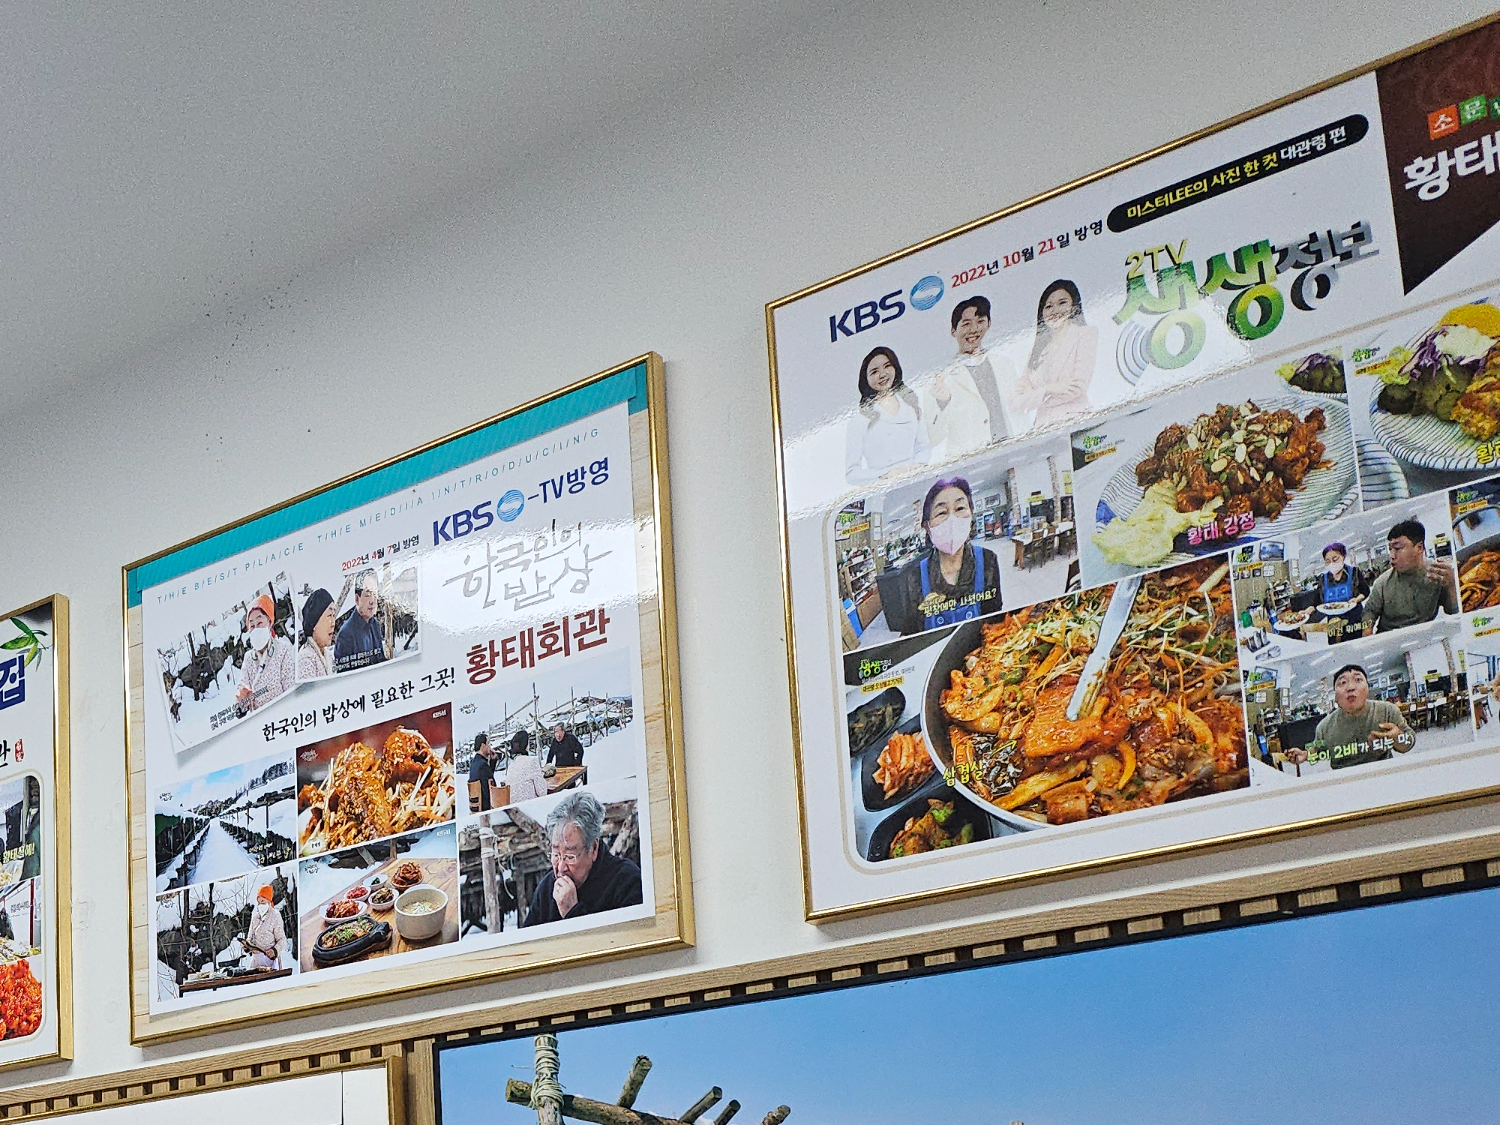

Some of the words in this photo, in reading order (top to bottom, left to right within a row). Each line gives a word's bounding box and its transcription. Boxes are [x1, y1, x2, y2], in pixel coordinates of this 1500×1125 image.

[1126, 181, 1209, 219] 미스터LEE의
[1210, 166, 1242, 188] 사진
[1242, 160, 1260, 177] 한
[1261, 153, 1279, 170] 컷
[1280, 134, 1328, 161] 대관령
[1329, 126, 1347, 144] 편
[951, 260, 999, 288] 2022년
[1002, 246, 1035, 269] 10월
[1037, 233, 1071, 255] 21일
[1074, 219, 1104, 241] 방영
[1124, 238, 1188, 279] 2TV
[829, 289, 906, 343] KBS
[433, 500, 495, 547] KBS
[1186, 522, 1219, 546] 황태
[1223, 510, 1256, 536] 강정
[157, 586, 188, 604] T/H/E
[194, 567, 238, 591] B/E/S/T
[245, 542, 304, 572] P/L/A/C/E
[317, 524, 351, 544] T/H/E
[341, 552, 370, 572] 2022년
[370, 545, 385, 560] 4월
[386, 540, 401, 553] 7일
[401, 534, 420, 550] 방영
[466, 607, 611, 685] 황태회관
[262, 710, 317, 742] 한국인의
[322, 695, 366, 725] 밥상에
[370, 680, 415, 709] 필요한
[418, 667, 456, 693] 그곳!
[942, 759, 985, 788] 삼겹살
[1333, 741, 1370, 762] 2배가
[1372, 735, 1395, 751] 되는
